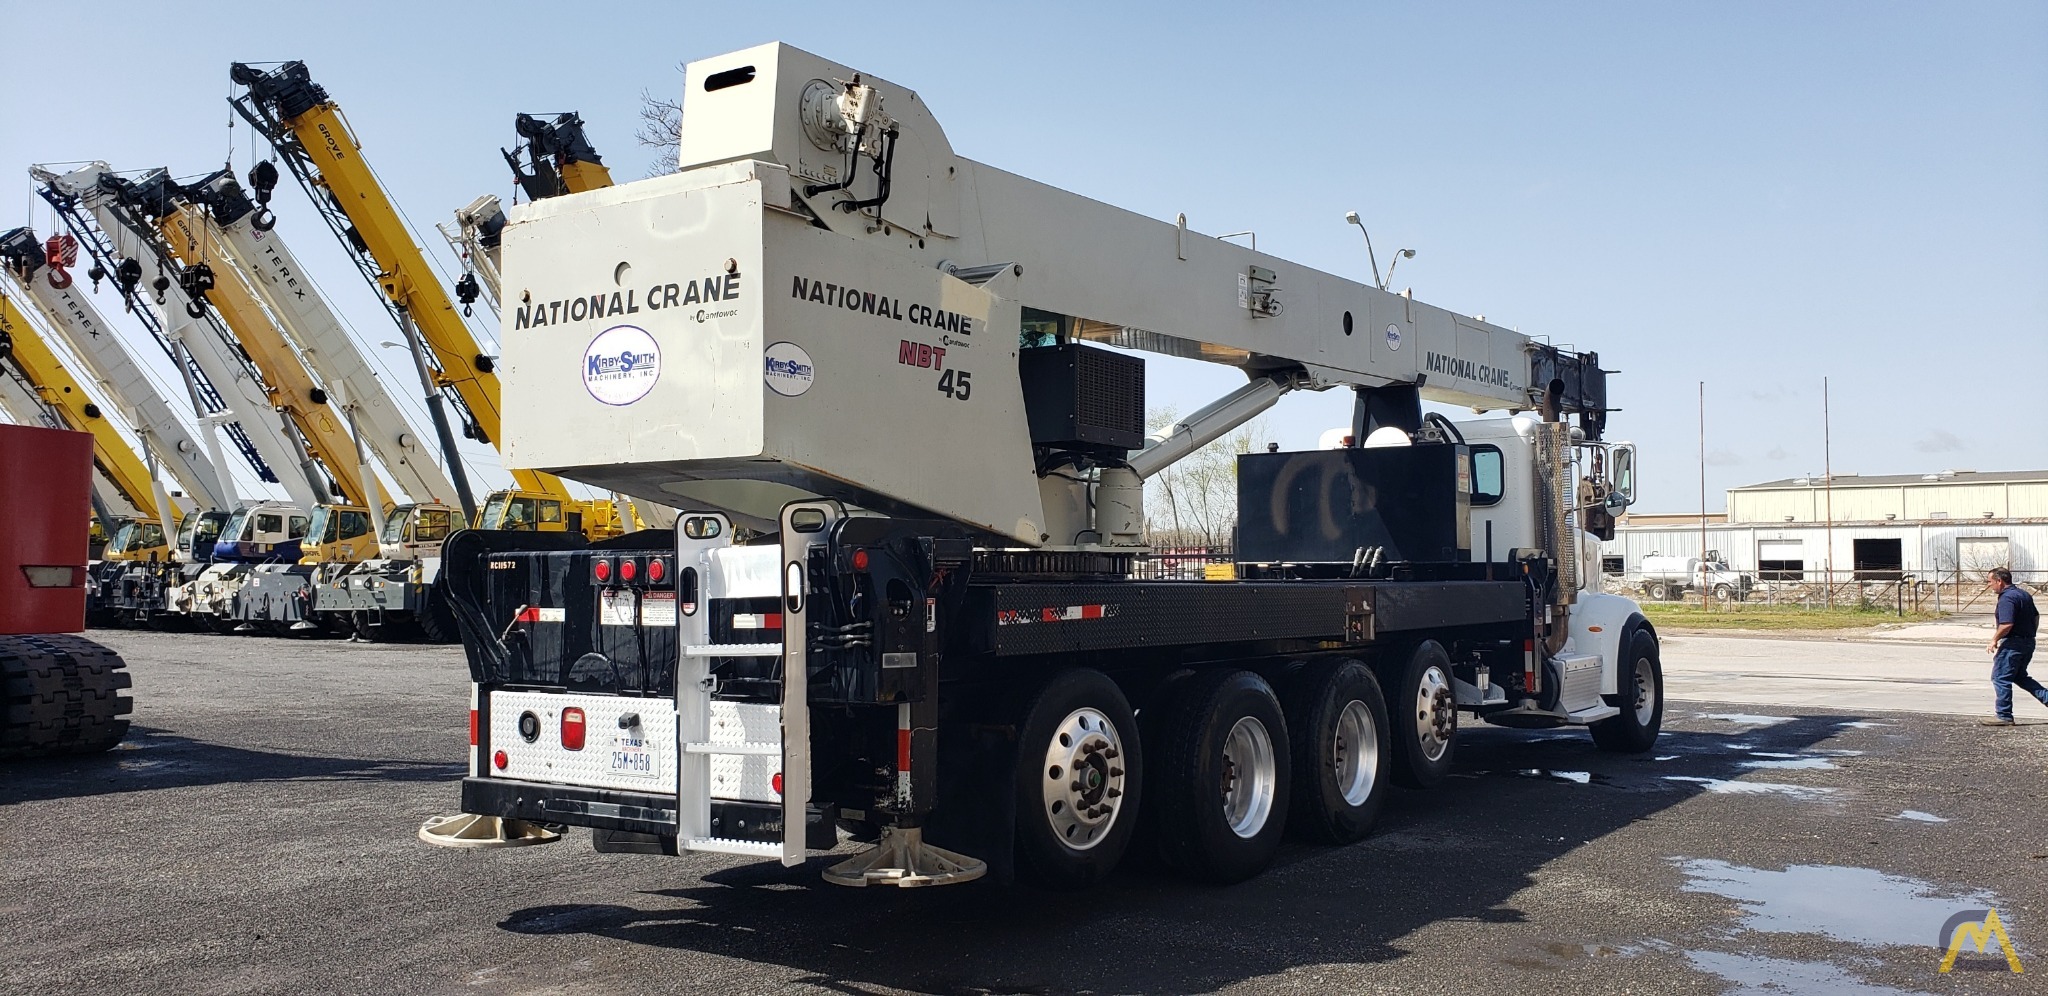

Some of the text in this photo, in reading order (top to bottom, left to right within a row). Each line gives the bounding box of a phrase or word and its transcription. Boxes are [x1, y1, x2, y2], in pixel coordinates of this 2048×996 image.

[318, 123, 345, 160] GROVE
[177, 219, 199, 247] GROVE
[265, 245, 306, 300] TEREX
[61, 291, 100, 339] TEREX
[515, 273, 741, 330] NATIONAL CRANE
[792, 275, 972, 336] NATIONAL CRANE
[898, 339, 946, 371] NBT
[1425, 351, 1509, 388] NATIONAL CRANE
[937, 368, 972, 401] 45
[621, 738, 643, 747] TEXAS
